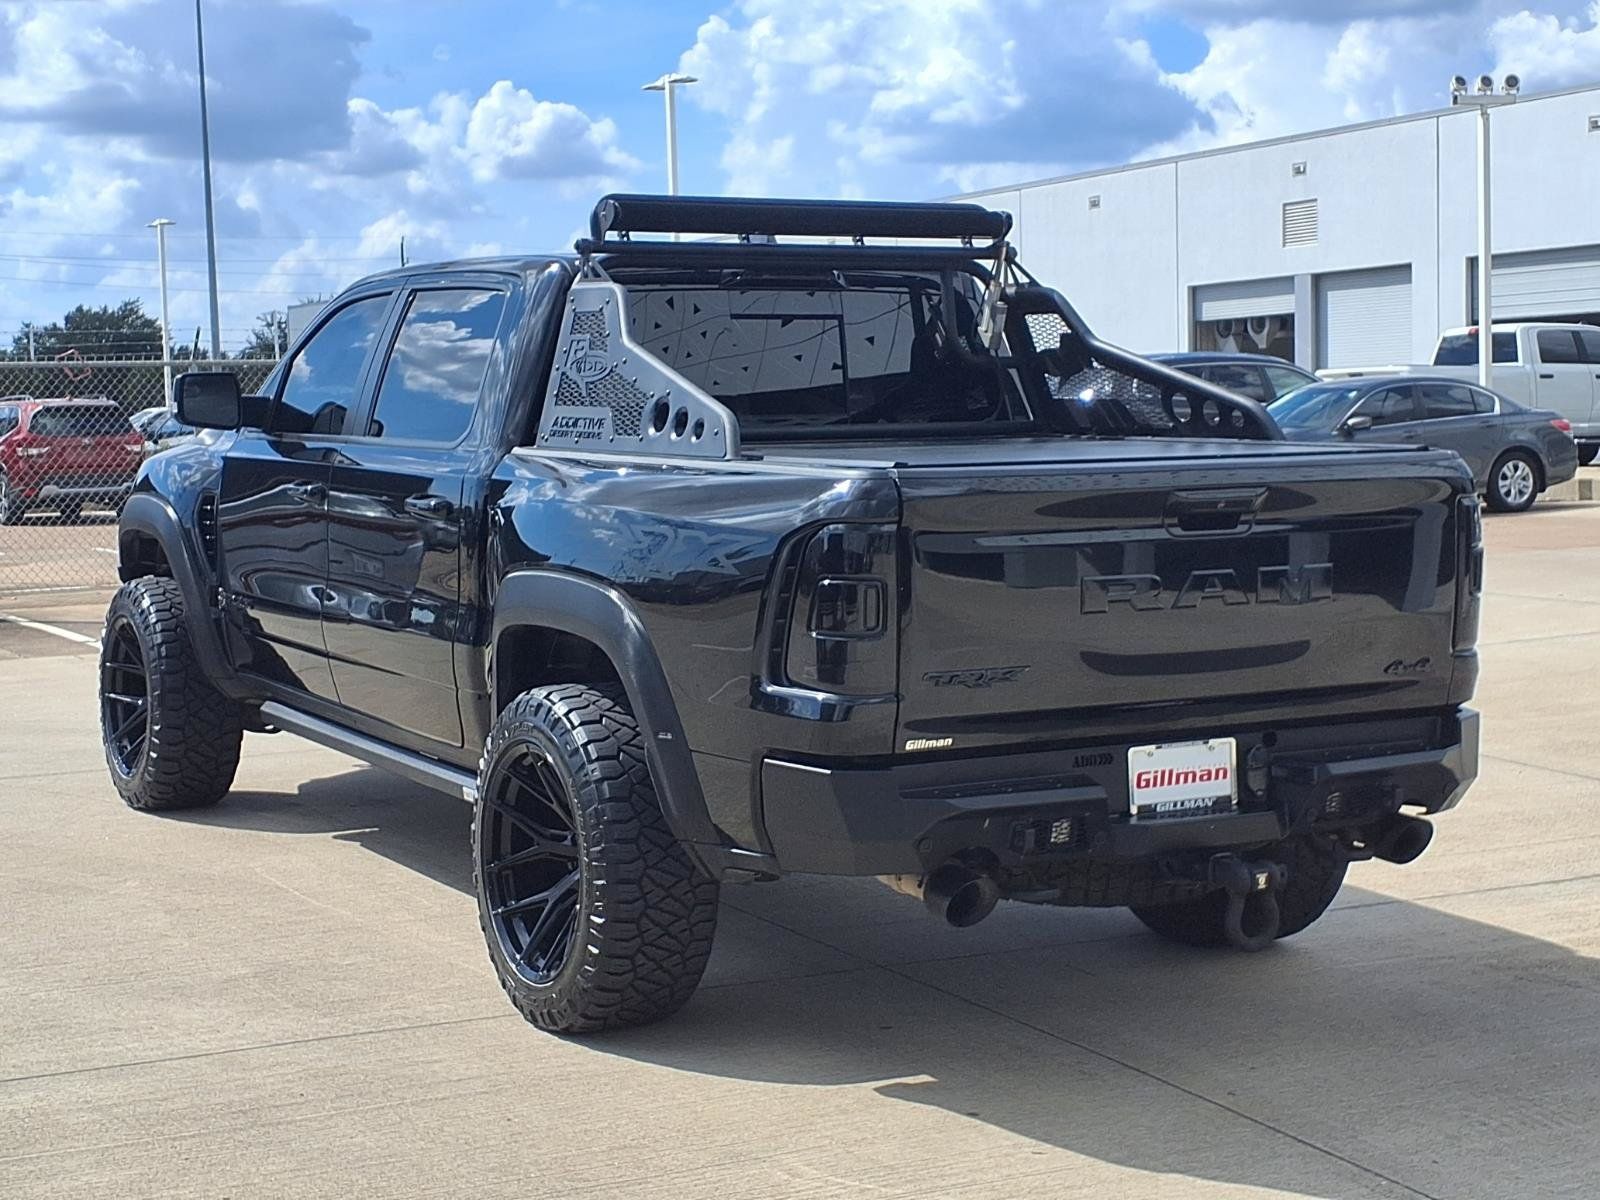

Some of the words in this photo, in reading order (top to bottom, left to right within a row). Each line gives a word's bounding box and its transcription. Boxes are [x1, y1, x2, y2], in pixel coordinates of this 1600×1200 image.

[1079, 563, 1334, 615] RAM
[905, 738, 953, 751] Gillman
[1135, 766, 1228, 789] Gillman
[1156, 798, 1214, 812] GILLMAN
